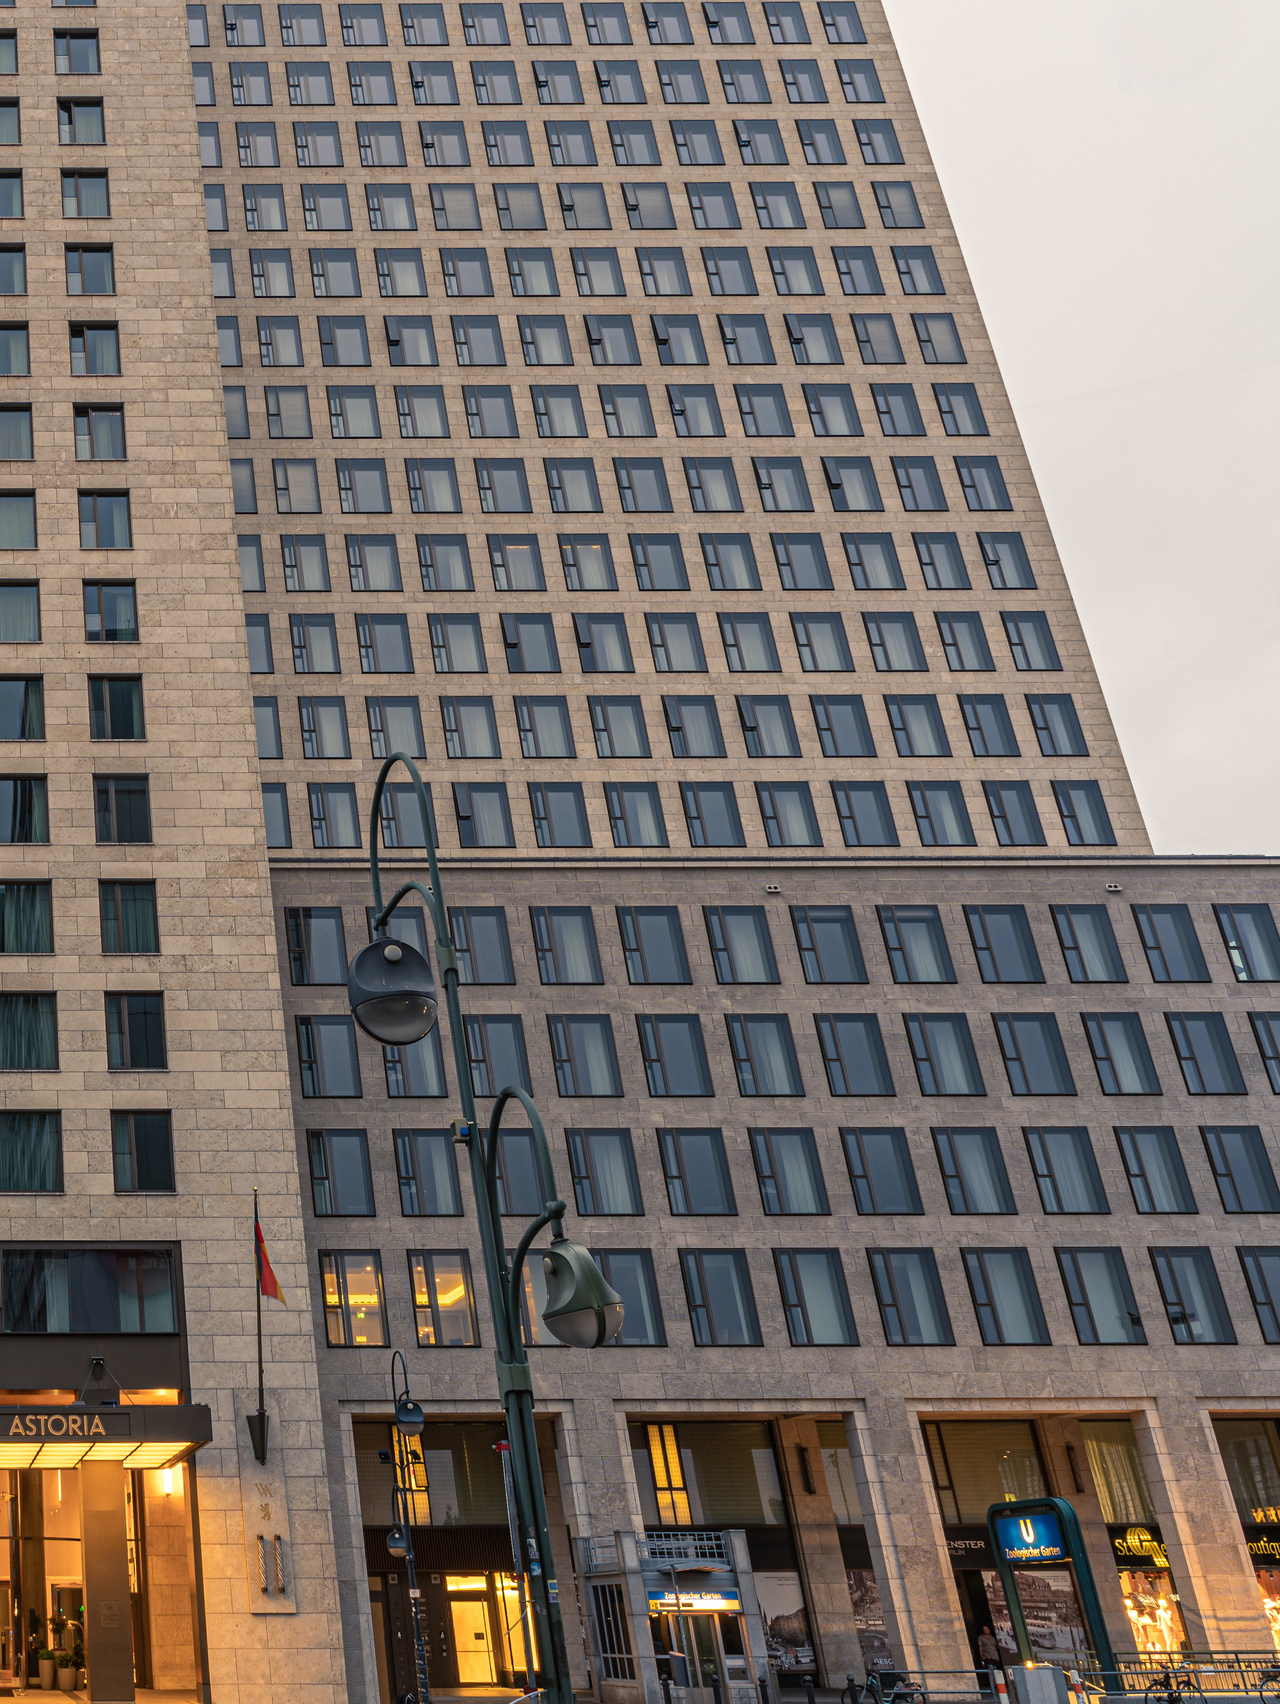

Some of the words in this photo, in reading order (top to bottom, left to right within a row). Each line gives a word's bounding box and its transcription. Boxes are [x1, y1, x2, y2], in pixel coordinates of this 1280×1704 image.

[8, 1414, 107, 1437] ASTORIA
[1019, 1518, 1036, 1544] U
[1005, 1546, 1040, 1560] Zoologischer
[1040, 1545, 1061, 1557] Garten
[1247, 1537, 1280, 1559] outiq
[701, 1592, 722, 1600] Garten
